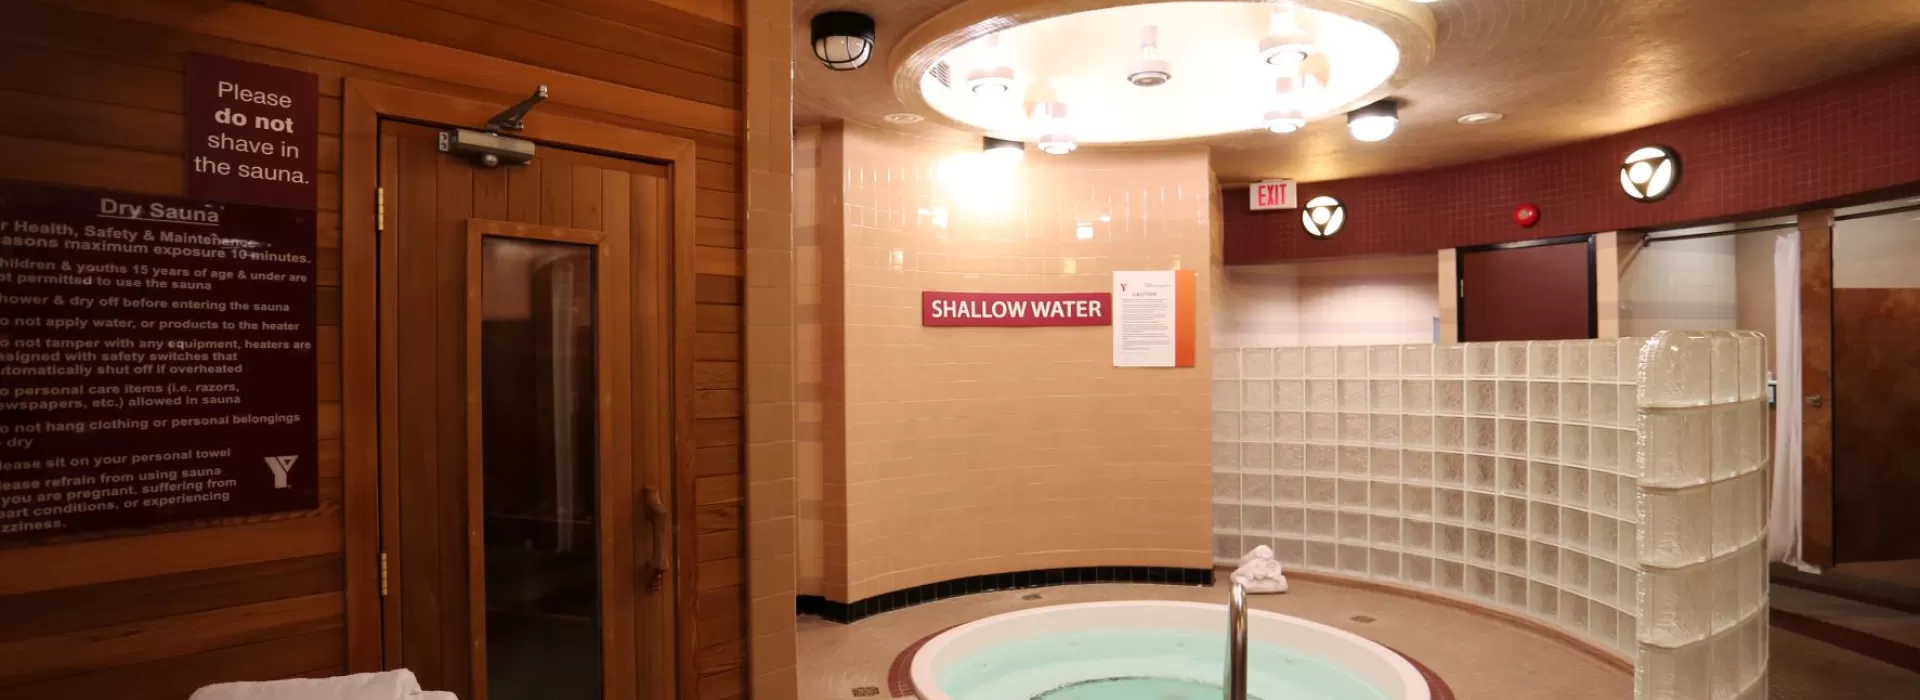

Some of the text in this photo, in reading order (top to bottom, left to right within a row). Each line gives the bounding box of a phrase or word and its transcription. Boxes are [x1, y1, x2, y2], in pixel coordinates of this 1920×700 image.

[218, 80, 292, 109] Please
[214, 108, 294, 134] do not
[207, 132, 299, 159] shave in
[194, 156, 310, 184] the sauna.
[1258, 184, 1287, 206] EXIT
[100, 197, 219, 223] Dry Sauna
[14, 220, 79, 238] Health,
[84, 225, 138, 243] Safety
[143, 230, 155, 241] &
[64, 240, 149, 254] maximum
[153, 246, 226, 258] exposure
[231, 249, 247, 259] 10
[251, 250, 312, 263] minutes.
[60, 260, 72, 270] &
[76, 263, 128, 274] youths
[132, 265, 148, 274] 15
[152, 267, 190, 277] years
[193, 269, 209, 277] of
[210, 271, 234, 281] age
[237, 270, 247, 280] &
[250, 271, 286, 282] under
[17, 274, 92, 285] permitted
[97, 276, 111, 286] to
[116, 278, 142, 287] use
[145, 279, 168, 288] the
[171, 281, 212, 290] sauna
[53, 295, 65, 305] &
[69, 295, 94, 308] dry
[98, 297, 120, 307] off
[123, 297, 168, 308] before
[172, 300, 226, 312] entering
[229, 301, 250, 311] the
[253, 303, 290, 312] sauna
[931, 299, 1102, 318] SHALLOW WATER
[14, 316, 41, 326] not
[45, 317, 88, 329] apply
[92, 318, 137, 329] water,
[140, 320, 156, 328] or
[159, 320, 219, 331] products
[222, 321, 235, 330] to
[238, 320, 258, 330] the
[262, 321, 300, 331] heater
[14, 338, 41, 348] not
[45, 338, 100, 350] tamper
[103, 338, 135, 348] with
[138, 340, 163, 350] any
[244, 339, 290, 349] heaters
[293, 341, 312, 349] are
[64, 351, 97, 361] with
[101, 351, 145, 363] safety
[149, 352, 209, 361] switches
[212, 352, 238, 361] that
[97, 365, 129, 374] shut
[133, 364, 153, 374] off
[156, 364, 167, 374] if
[169, 364, 243, 374] overheated
[14, 385, 84, 398] personal
[88, 386, 120, 394] care
[124, 384, 164, 393] items
[167, 383, 192, 395] (i.e.
[92, 397, 124, 410] etc.)
[128, 396, 182, 407] allowed
[186, 396, 198, 405] in
[202, 395, 241, 404] sauna
[14, 422, 42, 433] not
[45, 421, 85, 434] hang
[89, 418, 149, 430] clothing
[152, 419, 168, 428] or
[171, 415, 229, 429] personal
[232, 413, 301, 425] belongings
[6, 437, 33, 449] dry
[46, 456, 66, 468] sit
[69, 457, 89, 467] on
[93, 455, 129, 468] your
[131, 449, 192, 464] personal
[196, 447, 231, 458] towel
[45, 474, 96, 488] refrain
[100, 472, 134, 483] from
[138, 469, 178, 481] using
[181, 467, 221, 477] sauna
[1, 494, 32, 507] you
[37, 492, 62, 502] are
[142, 481, 203, 494] suffering
[208, 478, 237, 488] from
[32, 501, 120, 517] conditions,
[123, 500, 139, 508] or
[142, 491, 230, 507] experiencing
